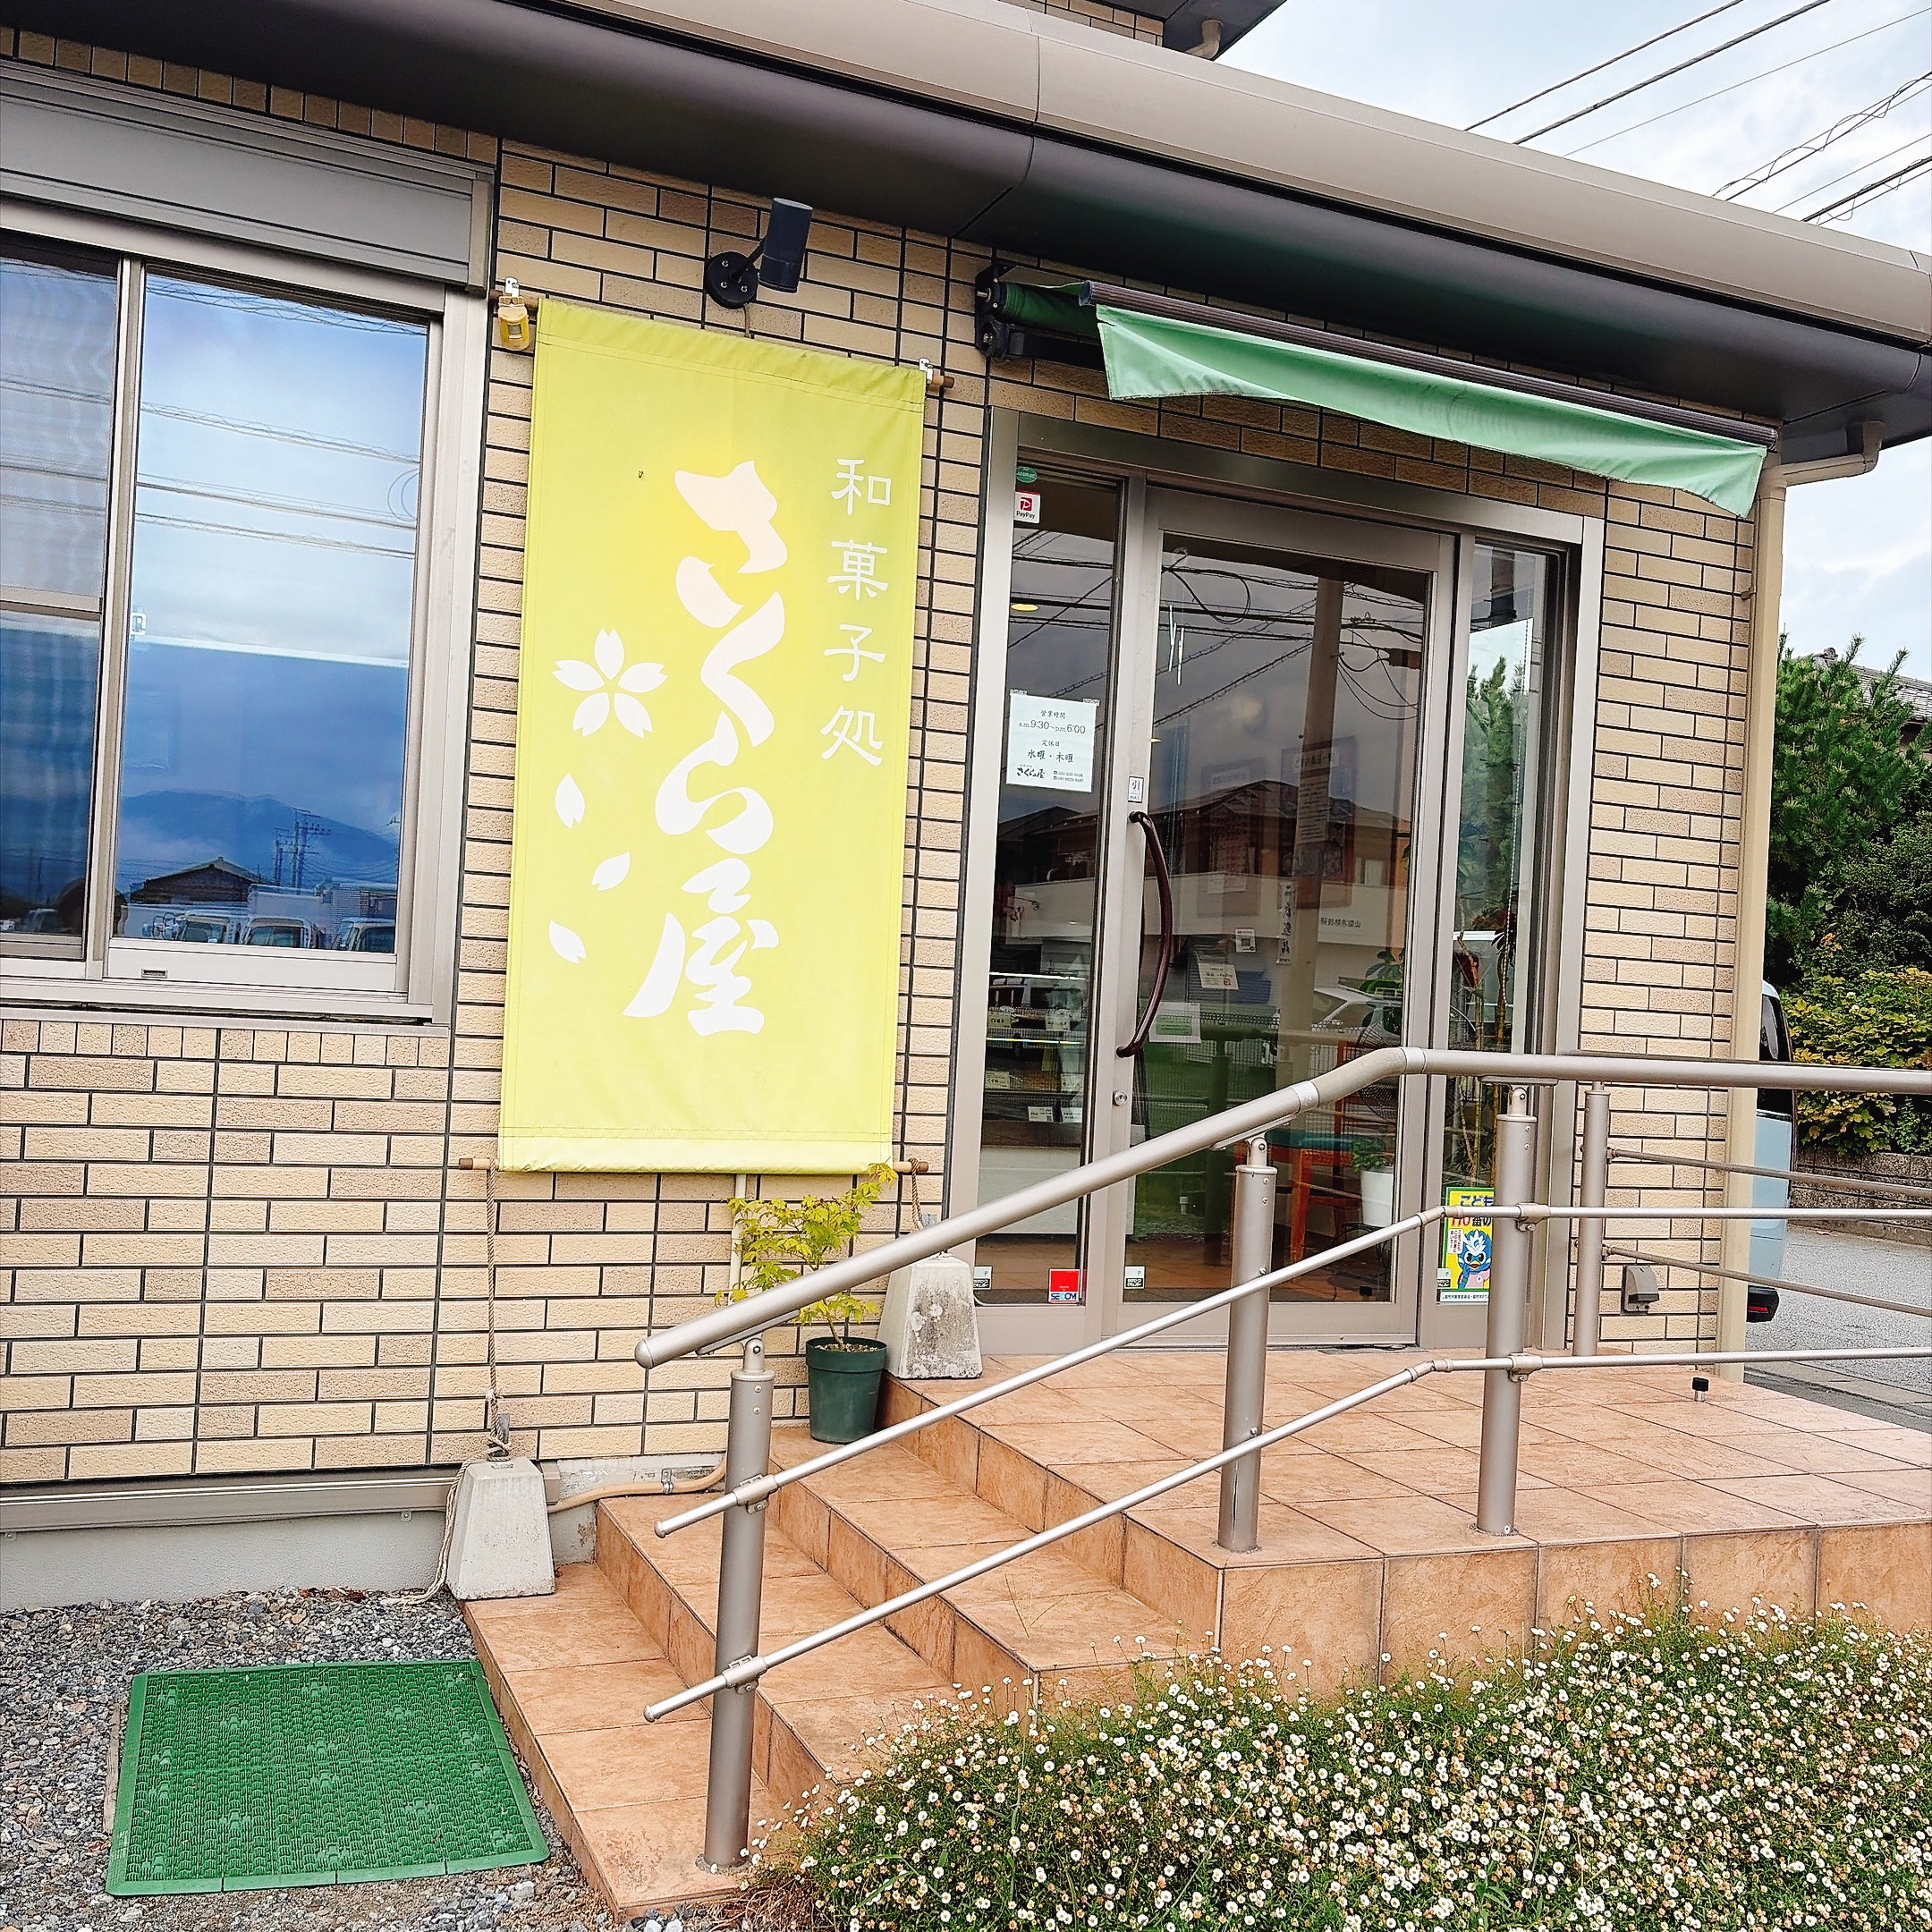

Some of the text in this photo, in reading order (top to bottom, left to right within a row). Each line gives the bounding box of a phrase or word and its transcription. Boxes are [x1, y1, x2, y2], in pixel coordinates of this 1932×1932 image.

[1016, 511, 1035, 519] PayPay
[820, 458, 892, 767] 和菓子処
[1040, 709, 1065, 719] 営業時間
[623, 460, 789, 1035] さくら屋
[1017, 767, 1045, 778] さくら屋
[1131, 780, 1140, 790] 引
